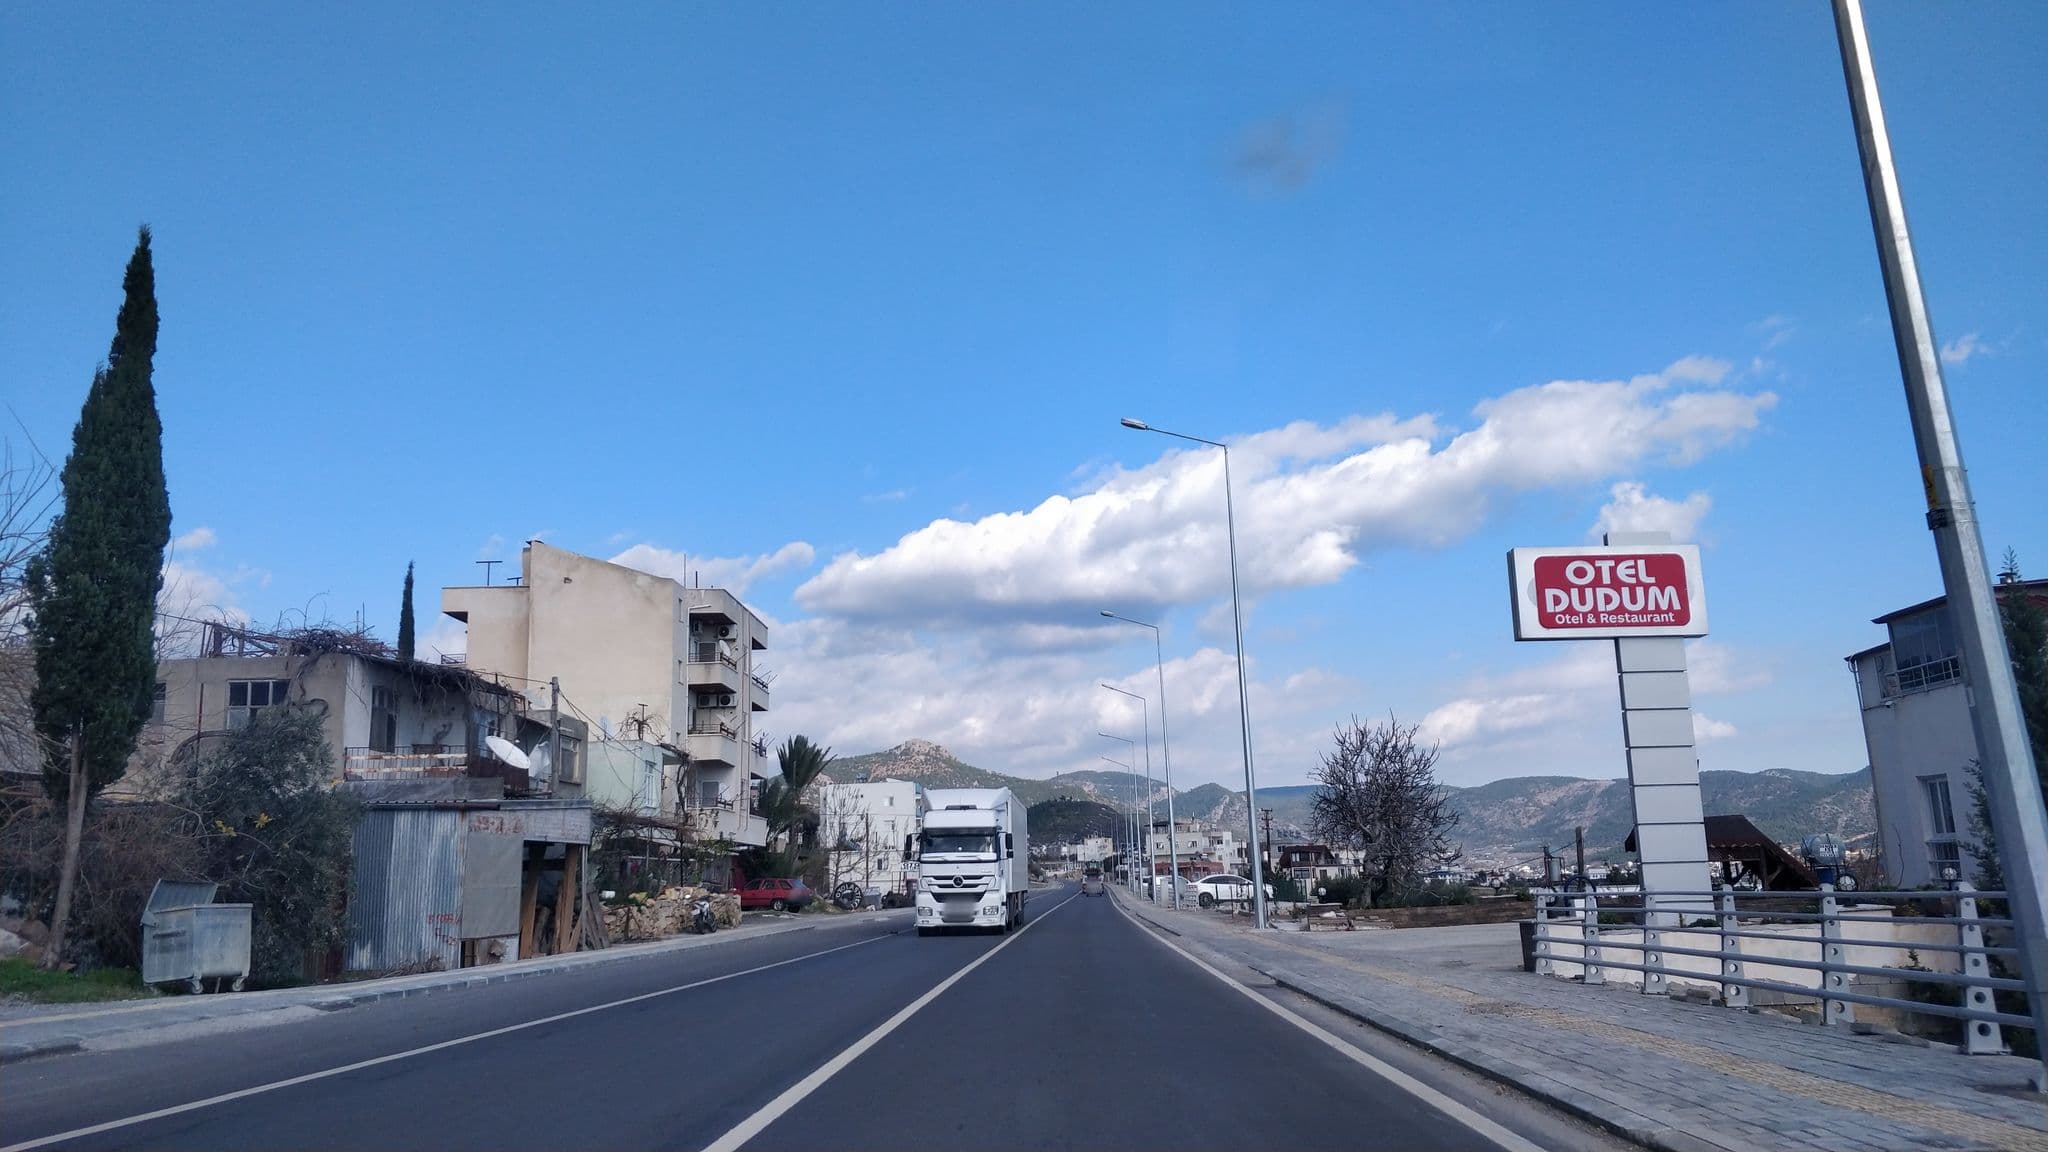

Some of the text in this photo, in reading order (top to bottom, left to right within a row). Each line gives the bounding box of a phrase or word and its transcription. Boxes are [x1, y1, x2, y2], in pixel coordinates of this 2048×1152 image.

[1565, 559, 1656, 586] OTEL
[1544, 585, 1682, 613] DUDUM
[1555, 612, 1675, 625] Otel & Restaurant
